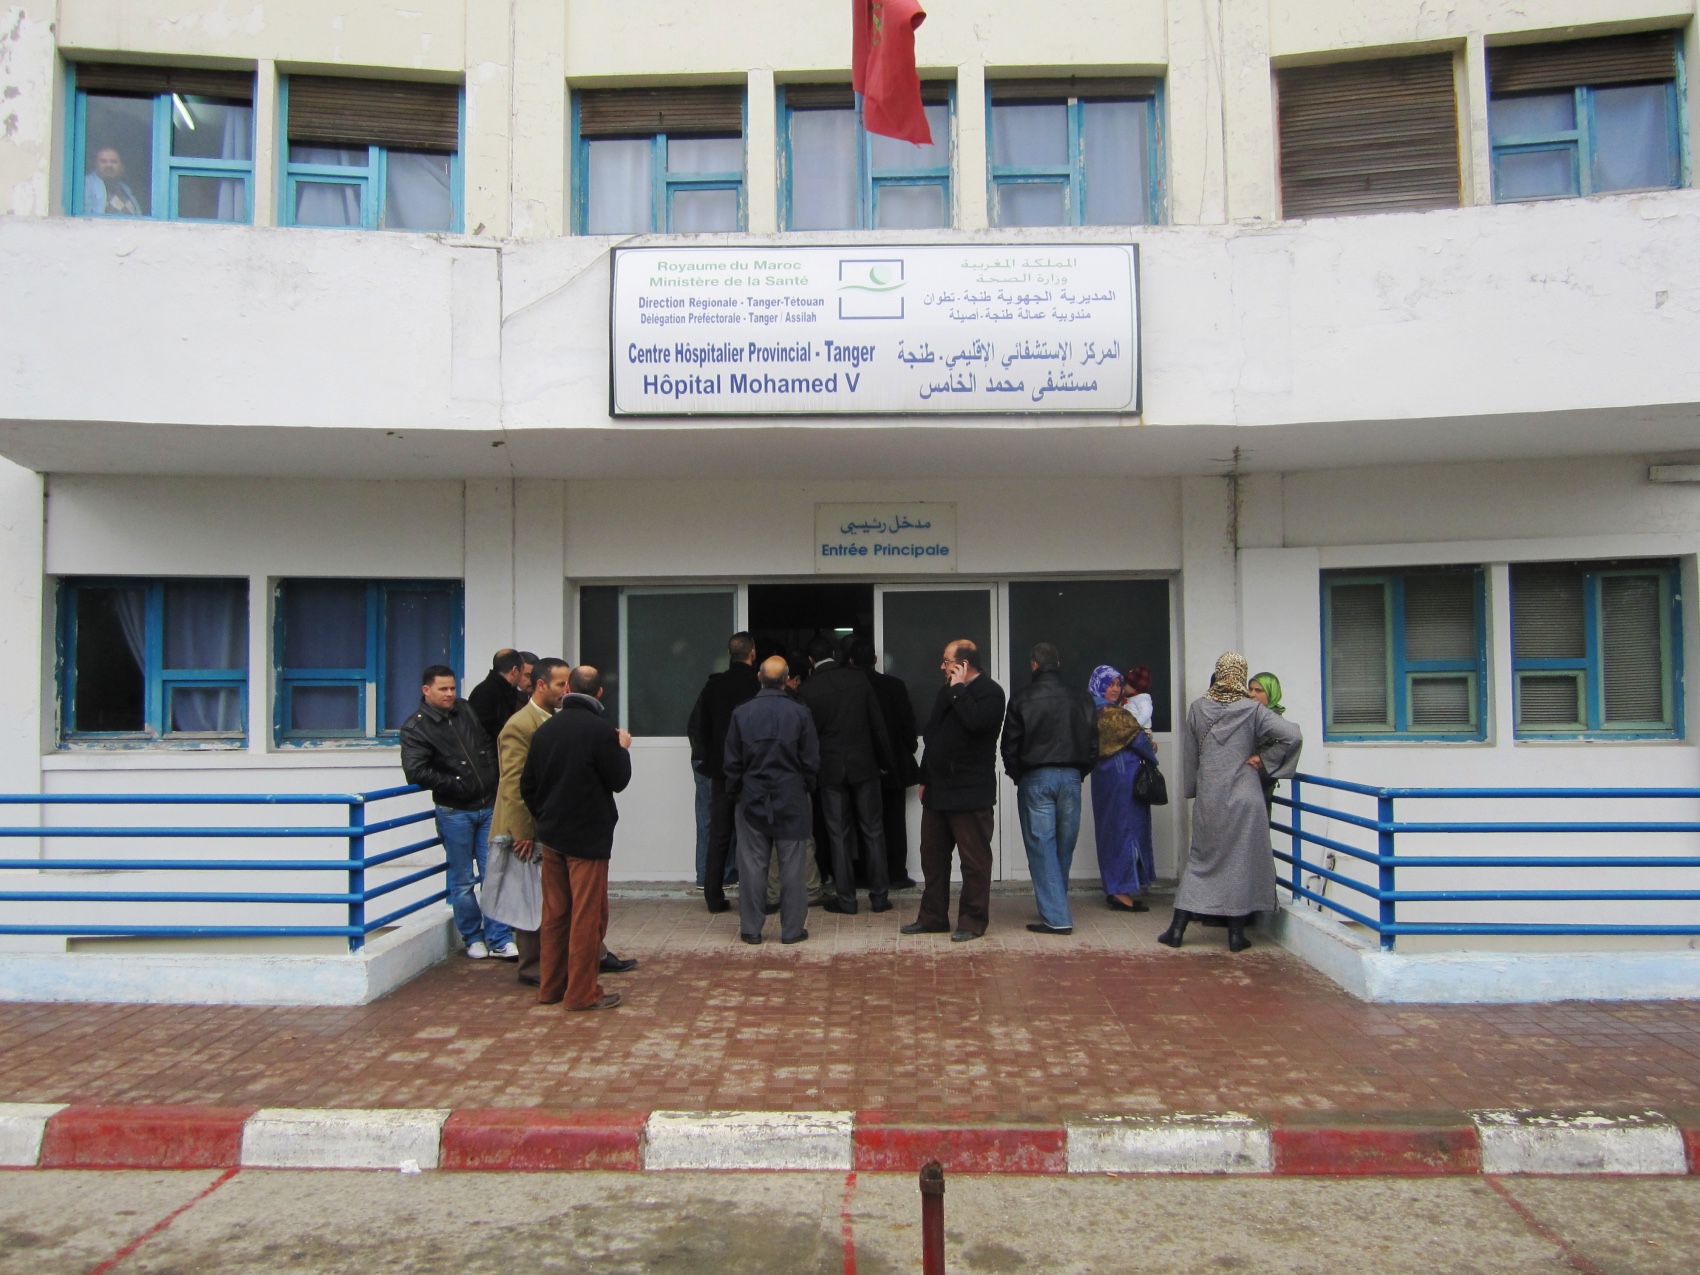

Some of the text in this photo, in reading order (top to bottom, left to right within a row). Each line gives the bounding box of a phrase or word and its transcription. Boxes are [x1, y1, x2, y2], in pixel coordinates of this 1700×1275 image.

[657, 261, 802, 273] Royaume du Maroc
[961, 258, 1077, 271] المملكة المغربية
[649, 275, 809, 287] Ministère de la Santé
[976, 273, 1068, 285] وزارة الصحة
[639, 296, 685, 309] Direction
[689, 296, 737, 310] Régionale
[747, 296, 824, 309] Tanger-Tétouan
[997, 289, 1052, 305] الجهوية
[1060, 289, 1116, 304] المديرية
[640, 313, 685, 326] Délégation
[749, 312, 778, 325] Tanger
[785, 311, 817, 323] Assilah
[1017, 308, 1046, 320] عمالة
[1052, 308, 1091, 322] مندوبية
[628, 342, 671, 364] Centre
[675, 342, 744, 368] Hôspitalier
[749, 342, 811, 363] Provincial
[824, 340, 875, 368] Tanger
[898, 340, 935, 369] طنجة
[1080, 339, 1120, 365] المركز
[643, 372, 860, 399] Hôpital Mohamed V
[919, 370, 1097, 402] مستشفى محمد الخامس
[840, 515, 931, 535] مدخل رئيسي
[822, 543, 949, 558] Entrée Principale
